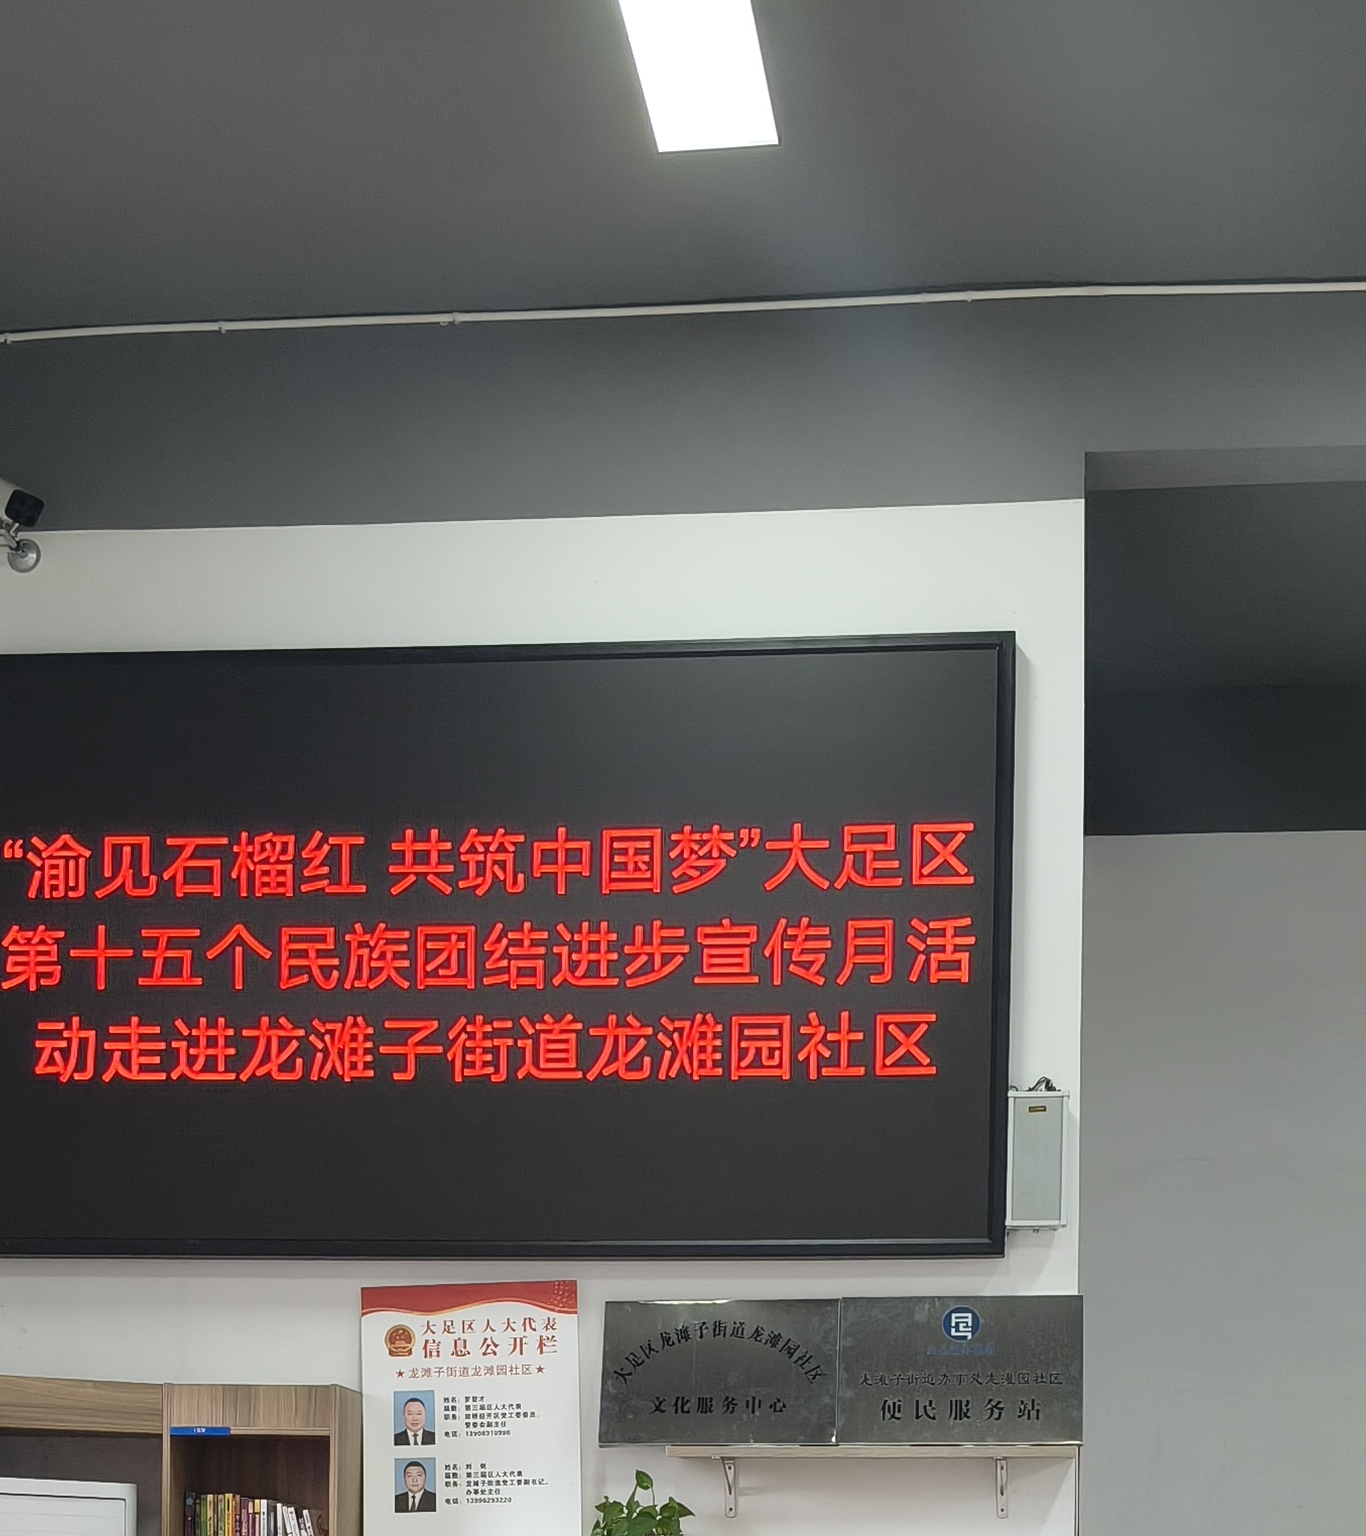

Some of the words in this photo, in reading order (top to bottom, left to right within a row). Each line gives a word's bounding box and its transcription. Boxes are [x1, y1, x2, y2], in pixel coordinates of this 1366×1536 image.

[1, 828, 369, 900] “渝见石榴红
[387, 821, 975, 898] 共筑中国梦”大足区
[0, 916, 977, 992] 第十五个民族团结进步宣传月活
[34, 1010, 937, 1083] 动走进龙滩子街道龙滩园社区
[421, 1316, 558, 1336] 大足区人大代表
[421, 1334, 559, 1360] 信息公开栏
[613, 1319, 826, 1385] 大足区龙滩子街道龙滩园社区
[407, 1363, 534, 1380] 龙滩子街道龙滩园社区
[649, 1396, 787, 1415] 文化服务中心
[879, 1398, 1042, 1422] 便民服务站
